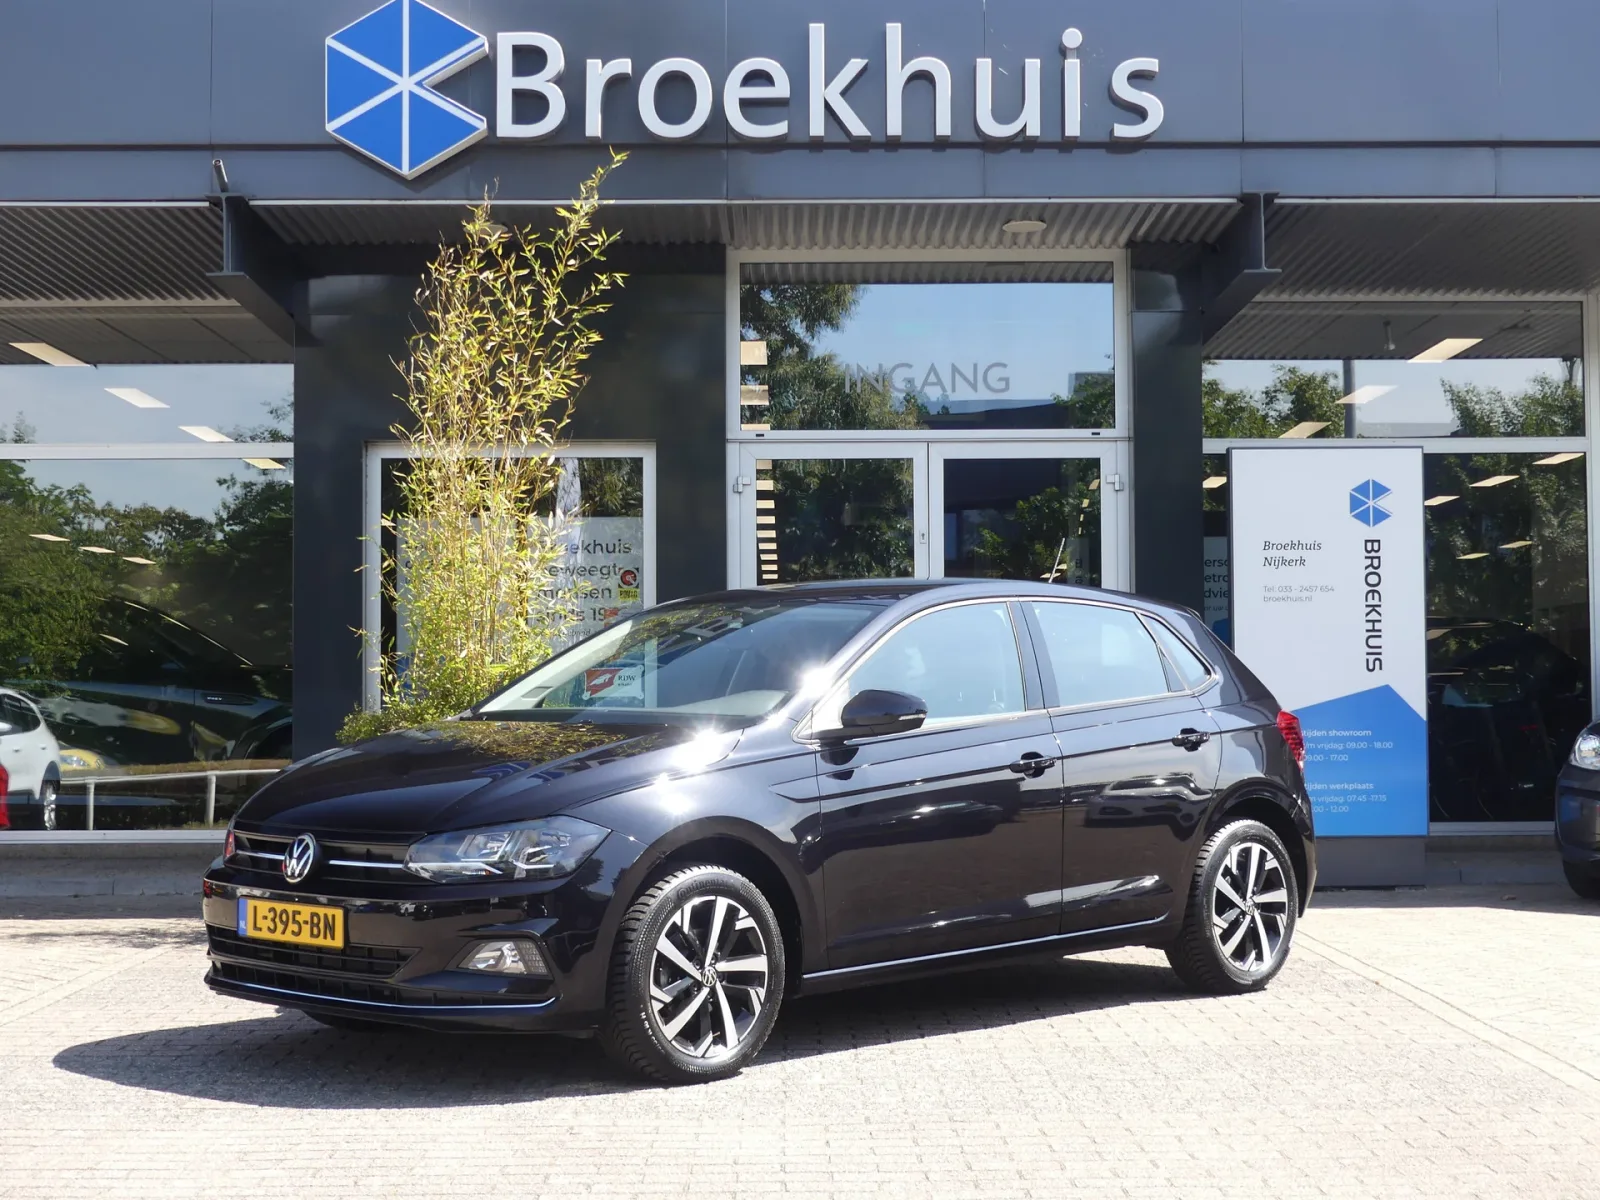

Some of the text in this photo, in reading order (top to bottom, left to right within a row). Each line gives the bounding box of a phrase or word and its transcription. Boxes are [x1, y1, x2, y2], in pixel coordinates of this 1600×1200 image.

[494, 22, 1166, 142] Broekhuis
[844, 362, 1010, 394] INGANG
[540, 538, 632, 554] ekhuis
[1263, 540, 1322, 551] Broekhuis
[1263, 556, 1307, 569] Nijkerk
[544, 563, 618, 579] eweegt
[1278, 585, 1293, 593] 033
[1299, 585, 1318, 593] 2457
[1320, 585, 1335, 593] 654
[1364, 539, 1383, 673] BROEKHUIS
[1328, 729, 1372, 737] showroom
[1316, 742, 1345, 750] vrijdag:
[1329, 782, 1374, 791] werkplaats
[252, 905, 336, 941] L-395-BN
